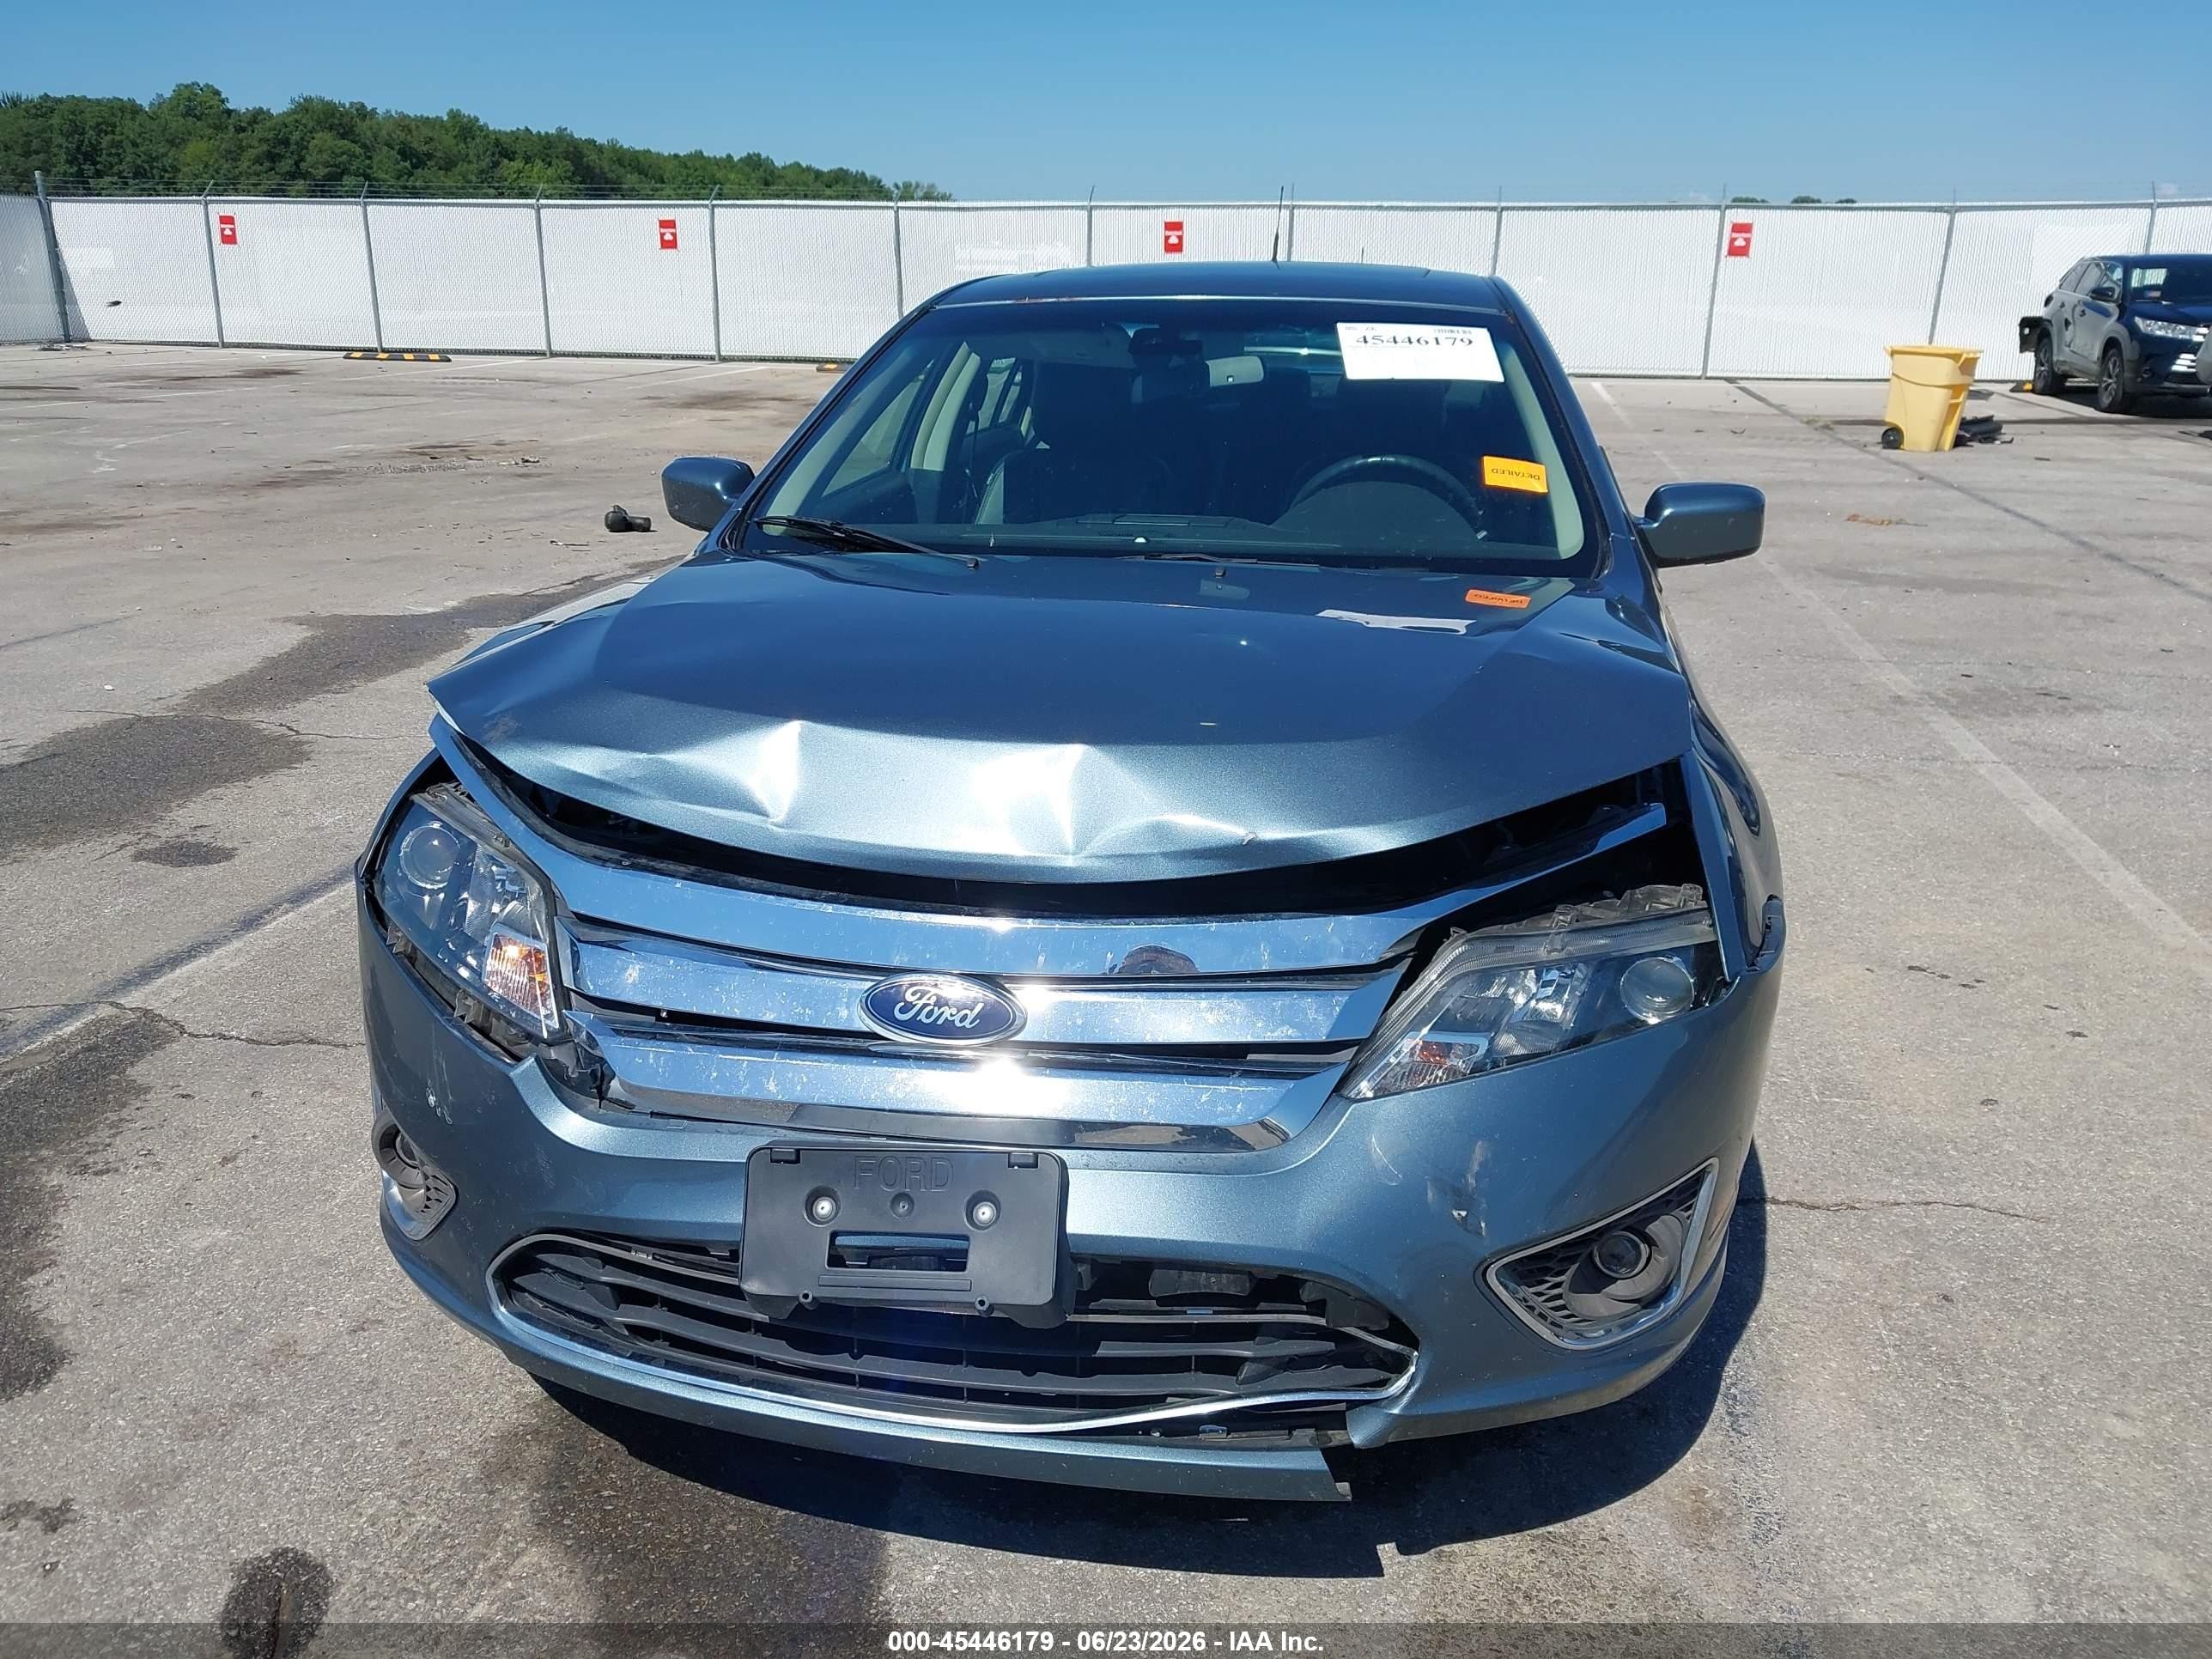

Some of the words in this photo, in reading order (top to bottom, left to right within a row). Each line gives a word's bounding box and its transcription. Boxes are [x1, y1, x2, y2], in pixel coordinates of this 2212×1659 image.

[1356, 335, 1473, 346] 45446179
[1491, 468, 1540, 481] DETAILED
[893, 986, 984, 1029] Ford
[854, 1156, 953, 1193] FORD
